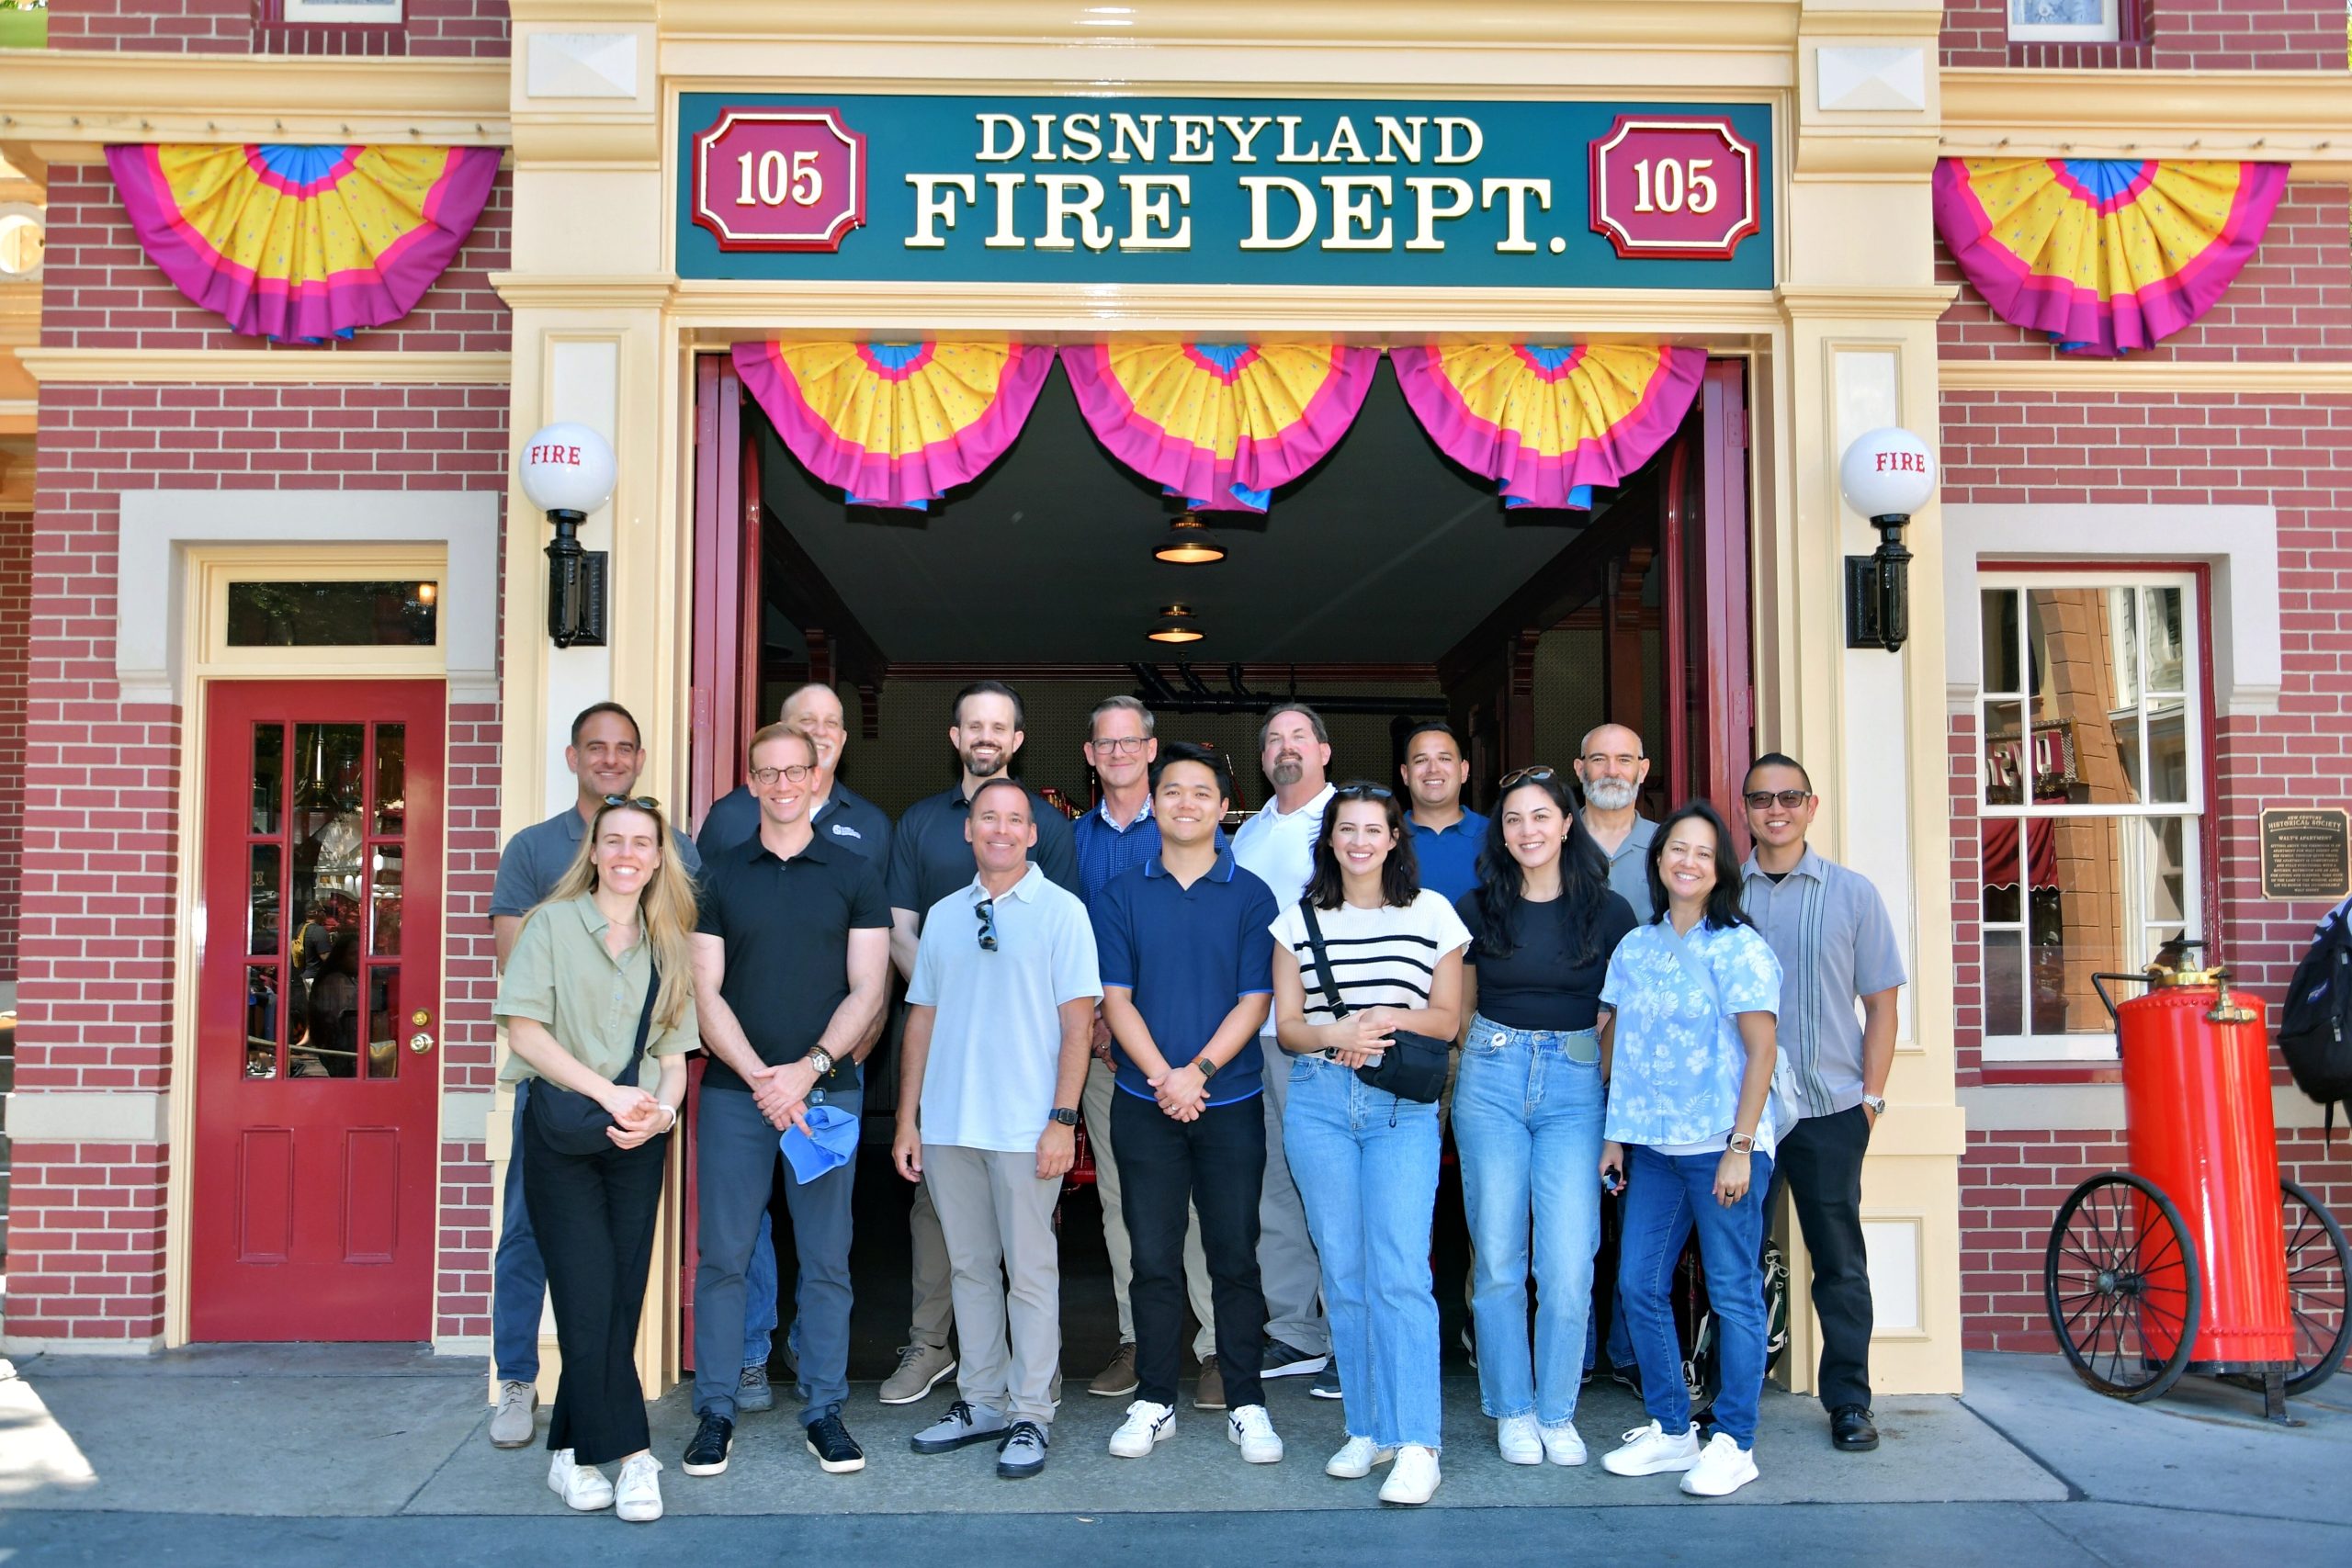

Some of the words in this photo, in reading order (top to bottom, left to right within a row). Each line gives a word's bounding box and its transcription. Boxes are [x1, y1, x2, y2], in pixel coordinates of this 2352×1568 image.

[976, 113, 1484, 164] DISNEYLAND
[736, 150, 823, 207] 105
[1634, 157, 1718, 213] 105
[904, 173, 1192, 252] FIRE
[1238, 175, 1566, 254] DEPT.
[530, 444, 582, 467] FIRE
[1875, 451, 1926, 474] FIRE
[2268, 820, 2310, 829] HISTORICAL
[2312, 820, 2342, 829] SOCIETY
